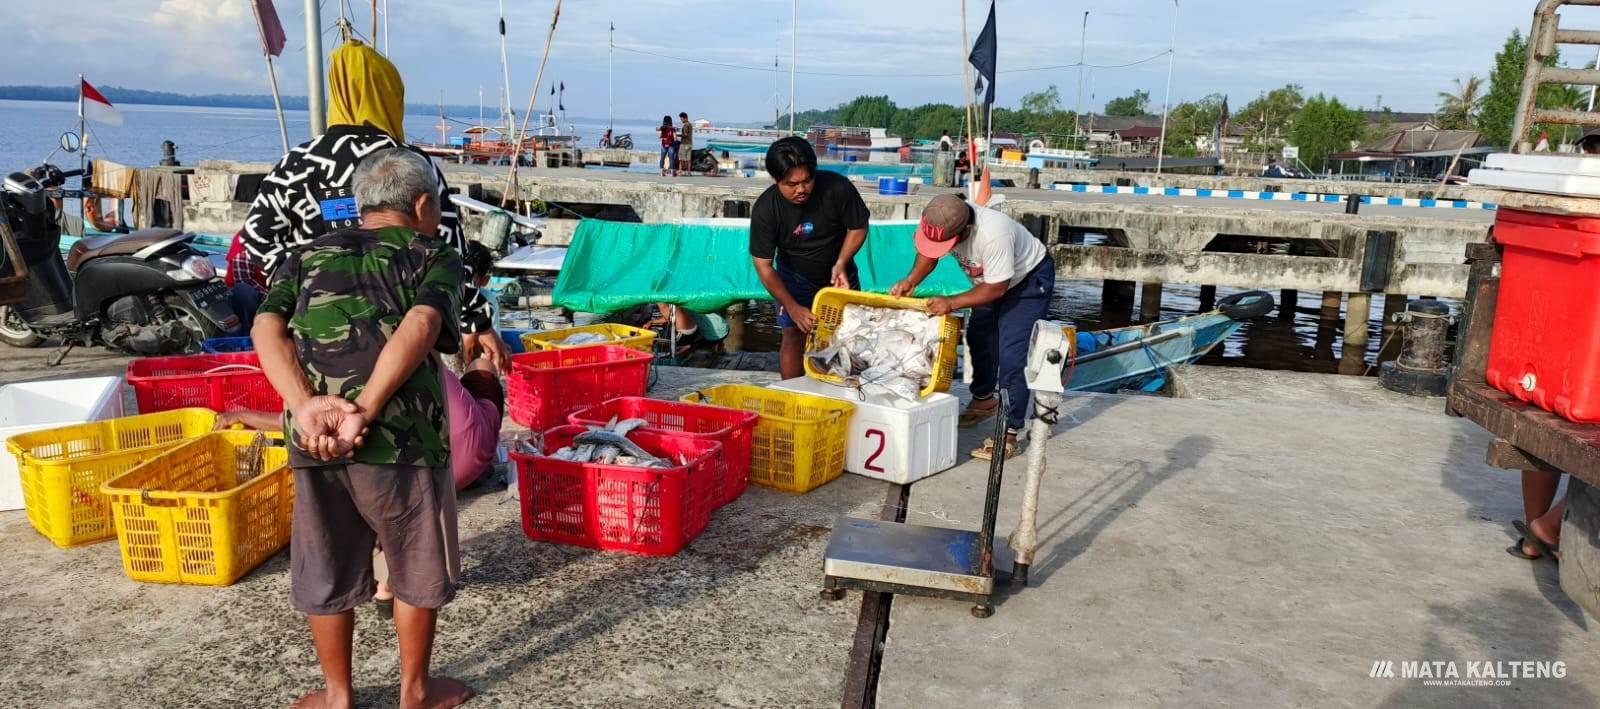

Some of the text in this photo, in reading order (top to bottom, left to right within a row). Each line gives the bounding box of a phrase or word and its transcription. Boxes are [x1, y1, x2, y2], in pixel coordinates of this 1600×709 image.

[325, 188, 346, 199] FE
[331, 219, 352, 229] RO
[864, 428, 886, 473] 2
